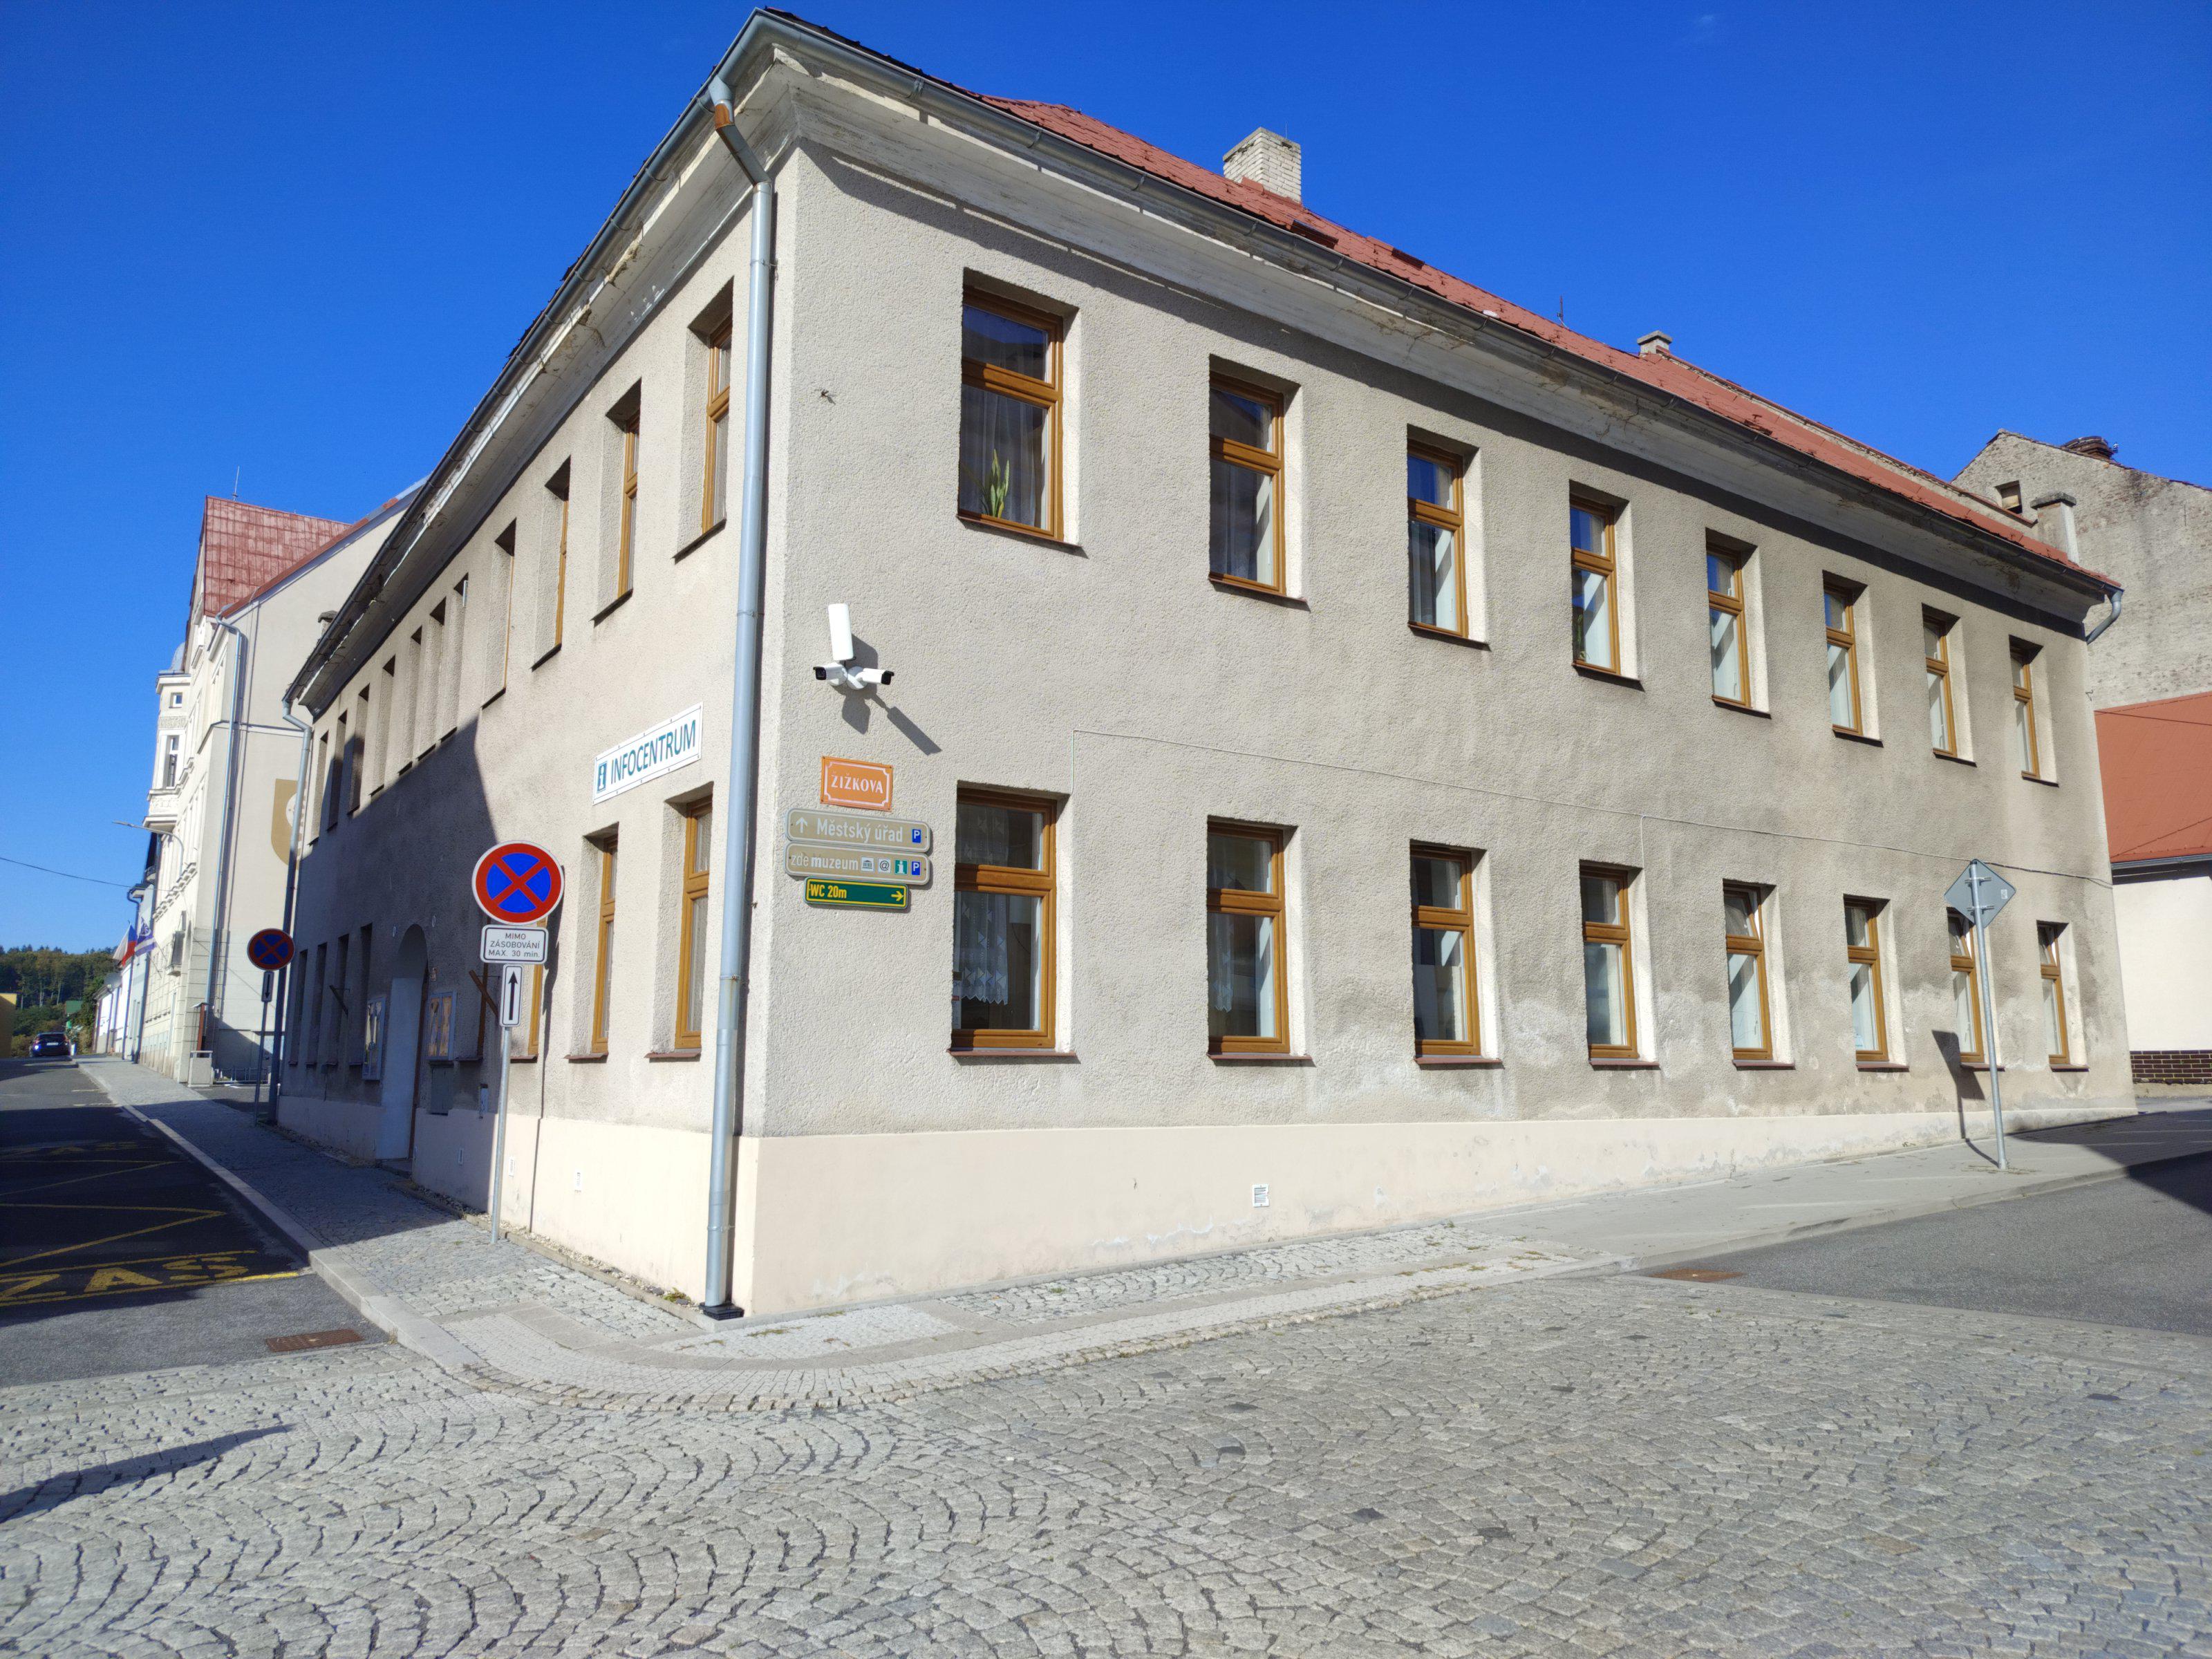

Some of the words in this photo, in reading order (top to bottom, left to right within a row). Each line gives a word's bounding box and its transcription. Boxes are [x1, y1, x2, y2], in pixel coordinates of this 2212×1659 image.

[611, 720, 696, 785] INFOCENTRUM
[830, 771, 883, 794] ŽIŽKOVA
[816, 818, 871, 843] Městský
[874, 824, 903, 843] úřad
[791, 852, 809, 867] zde
[811, 856, 859, 871] muzeum
[809, 883, 825, 897] WC
[827, 885, 847, 899] 20m
[490, 940, 540, 948] ZÁSOBOVÁNÍ
